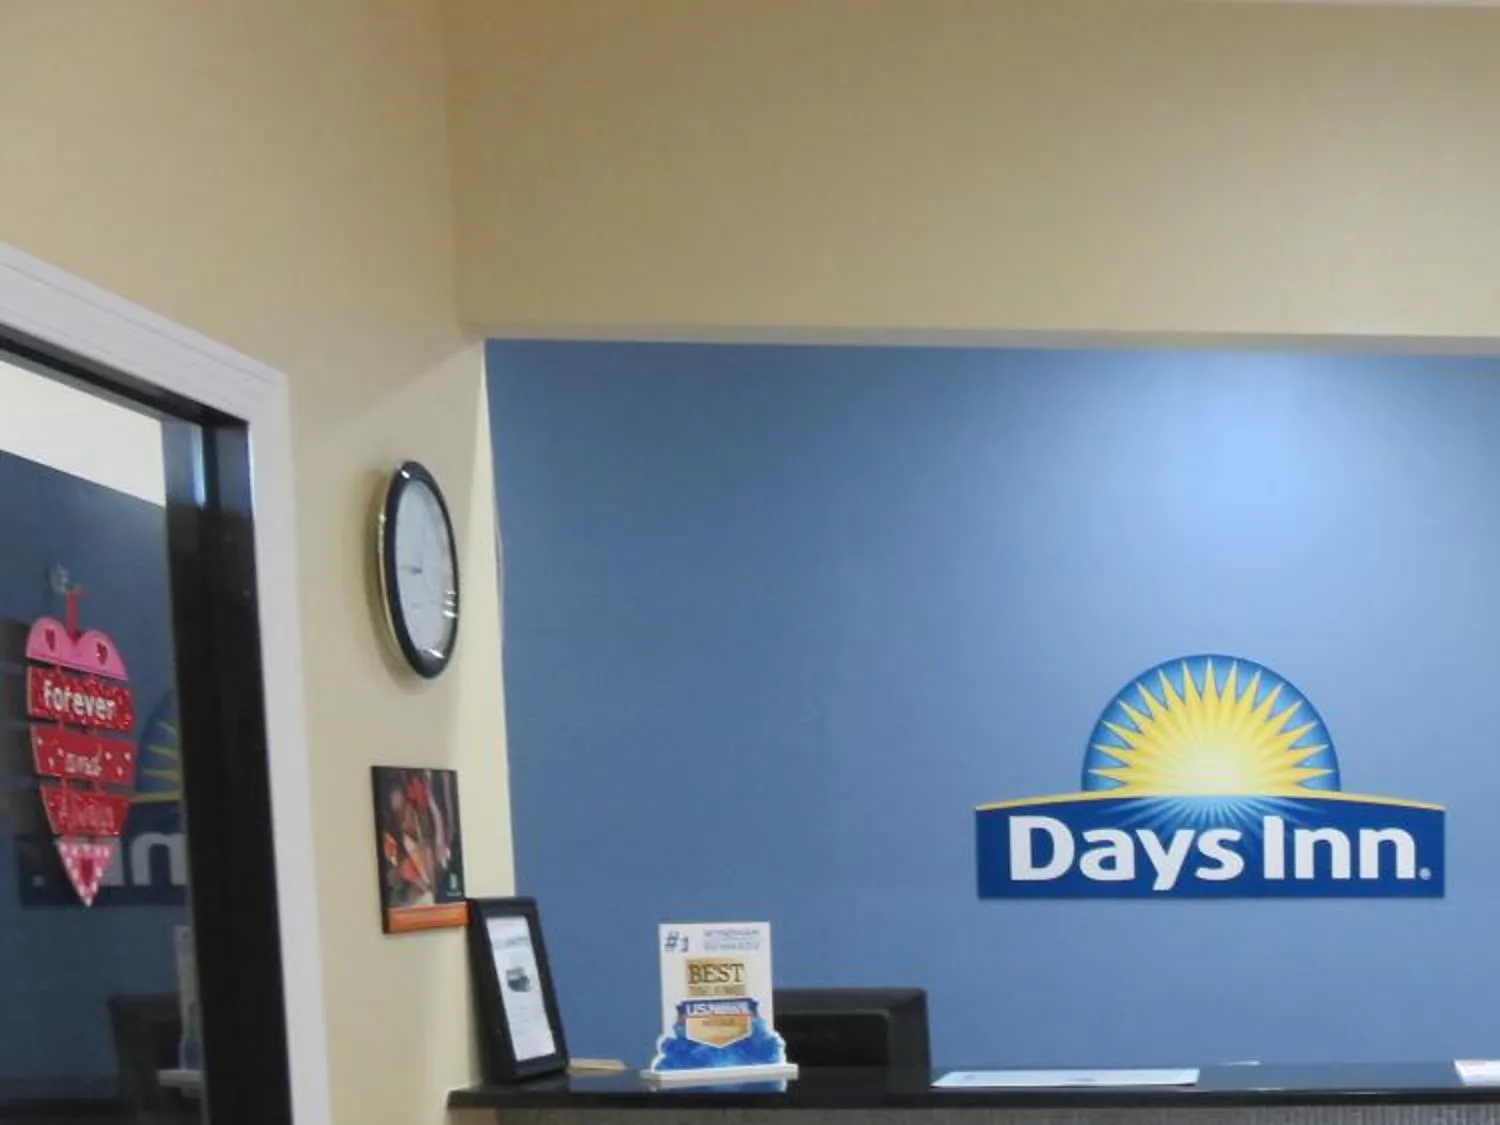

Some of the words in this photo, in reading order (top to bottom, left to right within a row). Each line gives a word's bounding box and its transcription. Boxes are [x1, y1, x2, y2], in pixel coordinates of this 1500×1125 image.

[42, 679, 117, 721] Forever
[1008, 815, 1245, 891] Days
[663, 930, 690, 953] #1
[687, 962, 745, 985] BEST
